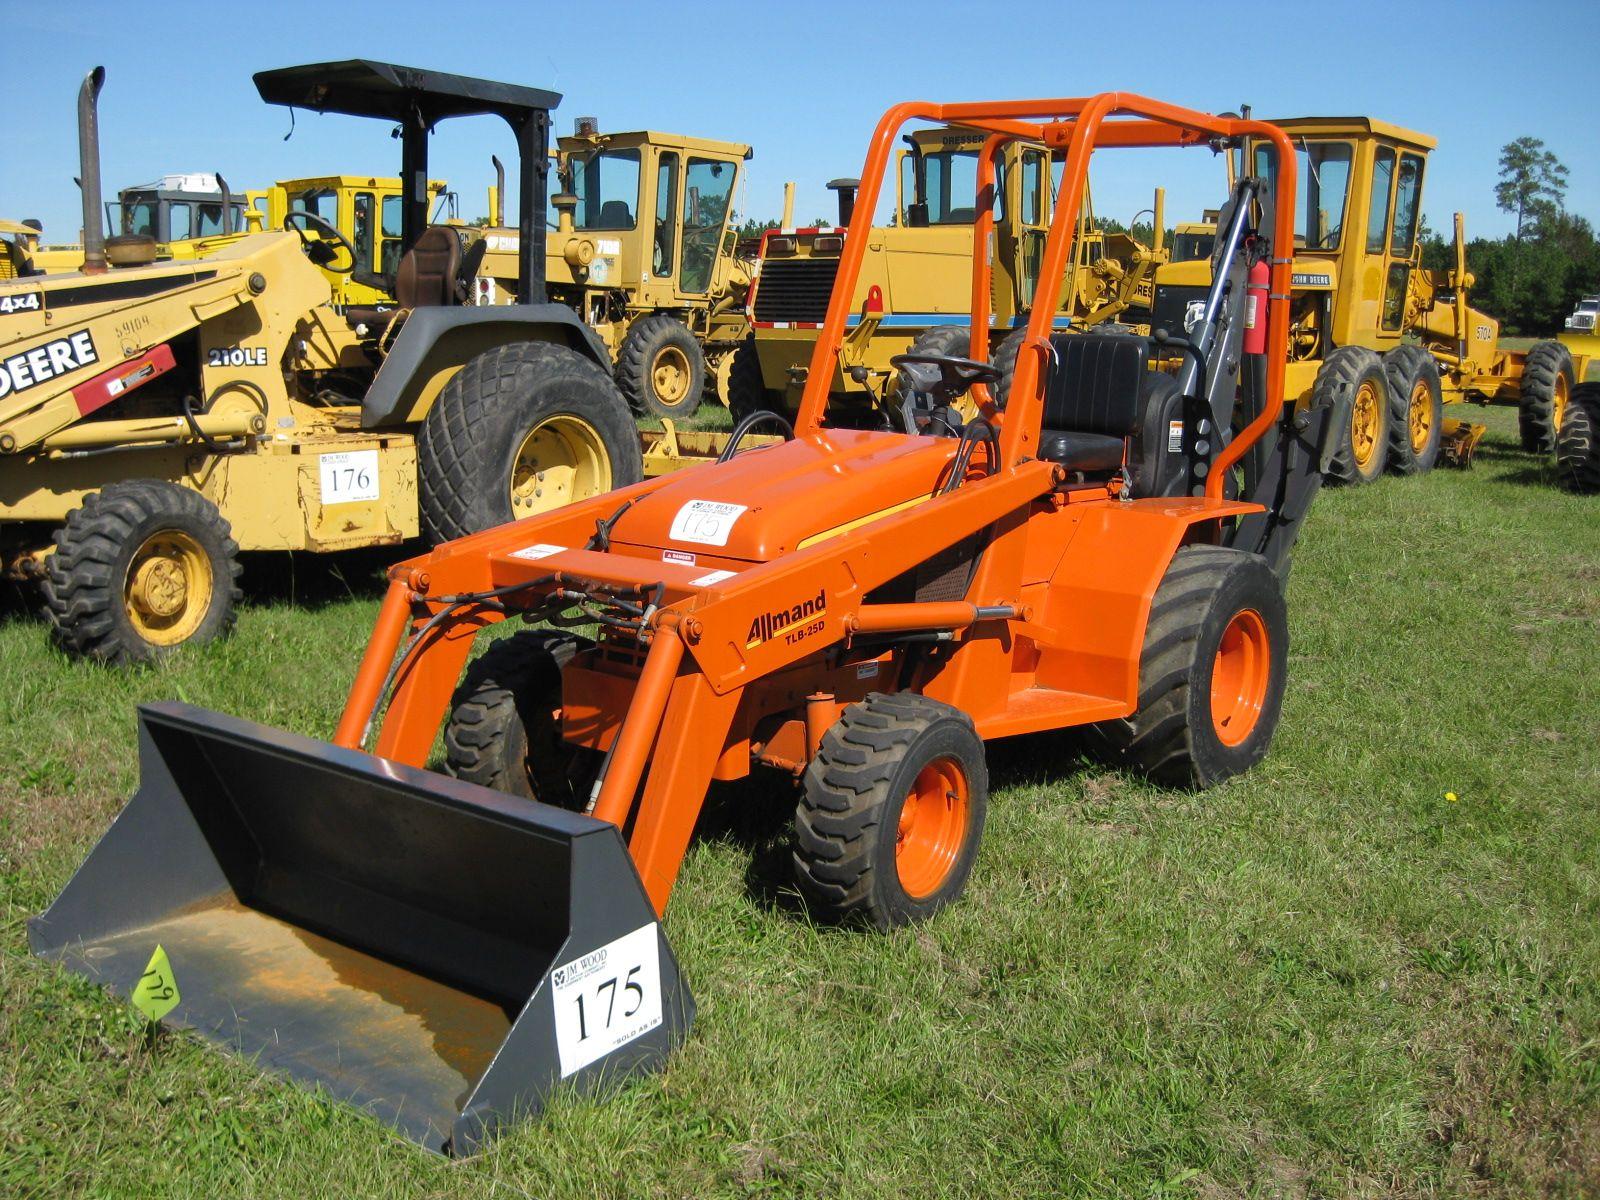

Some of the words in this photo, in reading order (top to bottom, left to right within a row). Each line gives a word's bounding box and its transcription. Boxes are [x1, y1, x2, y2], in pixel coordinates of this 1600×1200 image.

[942, 135, 985, 145] DRESSER
[1309, 276, 1329, 285] DEERE
[1, 293, 40, 313] 4x4
[208, 347, 267, 367] 210LE
[333, 466, 371, 491] 176
[682, 511, 725, 537] 175
[672, 553, 692, 561] DANGER
[746, 588, 826, 643] Allmand
[784, 620, 826, 646] TLB-25D
[565, 963, 578, 982] JM
[580, 949, 608, 971] WOOD
[573, 964, 643, 1044] 175
[638, 1023, 649, 1033] AS
